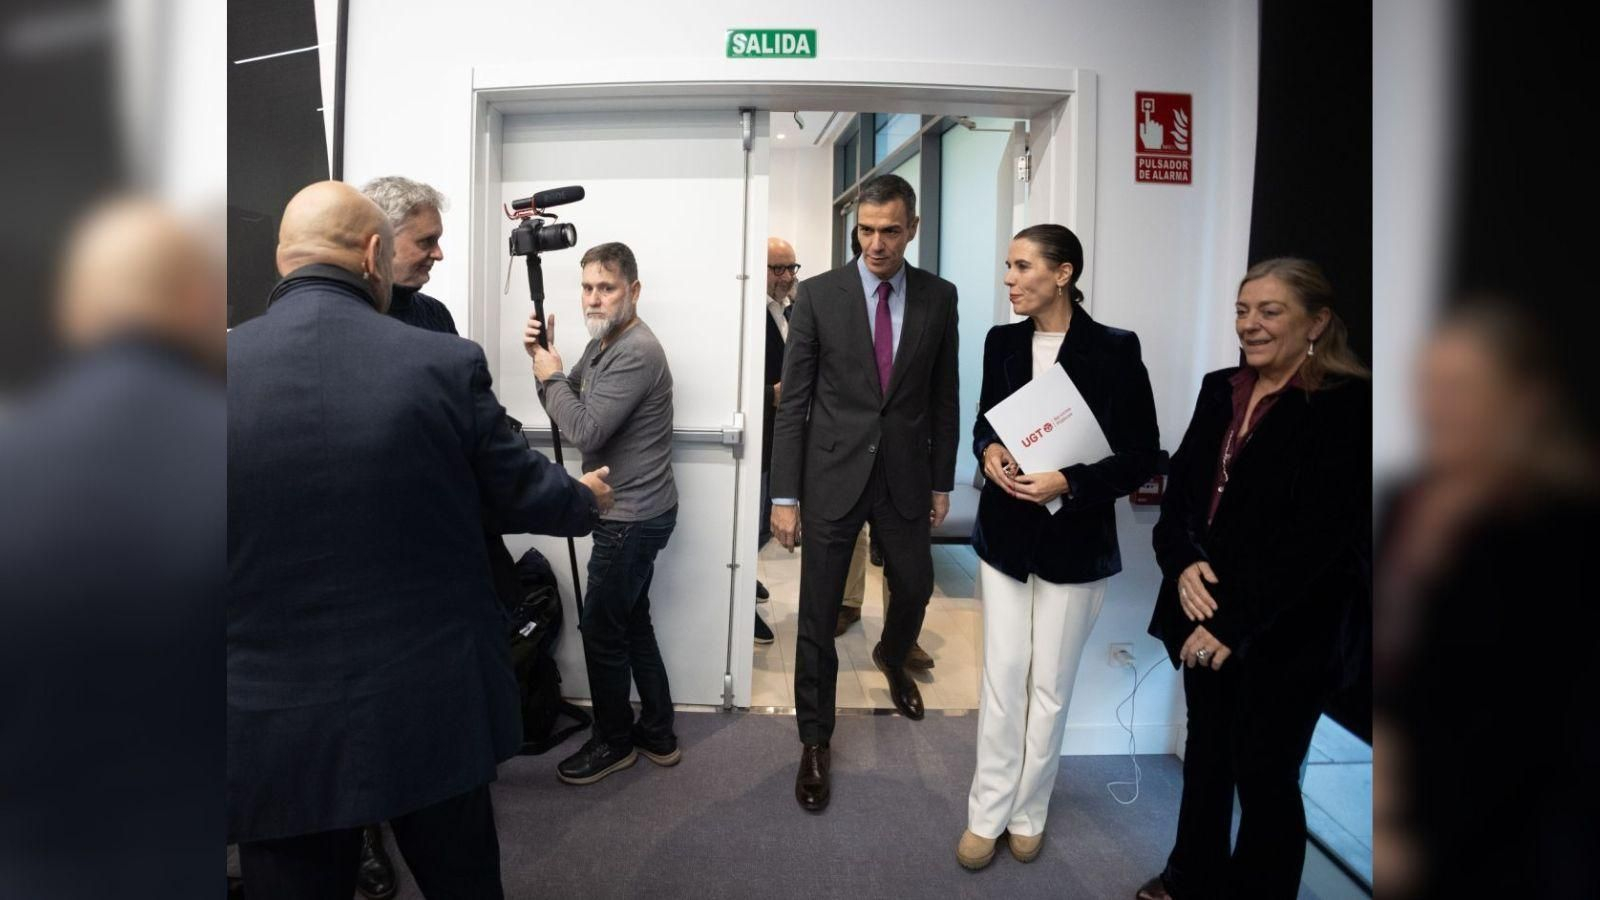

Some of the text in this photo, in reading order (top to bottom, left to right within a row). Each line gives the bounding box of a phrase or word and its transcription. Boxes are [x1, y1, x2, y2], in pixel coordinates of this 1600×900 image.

[732, 33, 811, 54] SALIDA
[1139, 158, 1188, 170] PULSADOR
[1139, 170, 1188, 181] DE ALARMA
[1021, 428, 1043, 448] UGT
